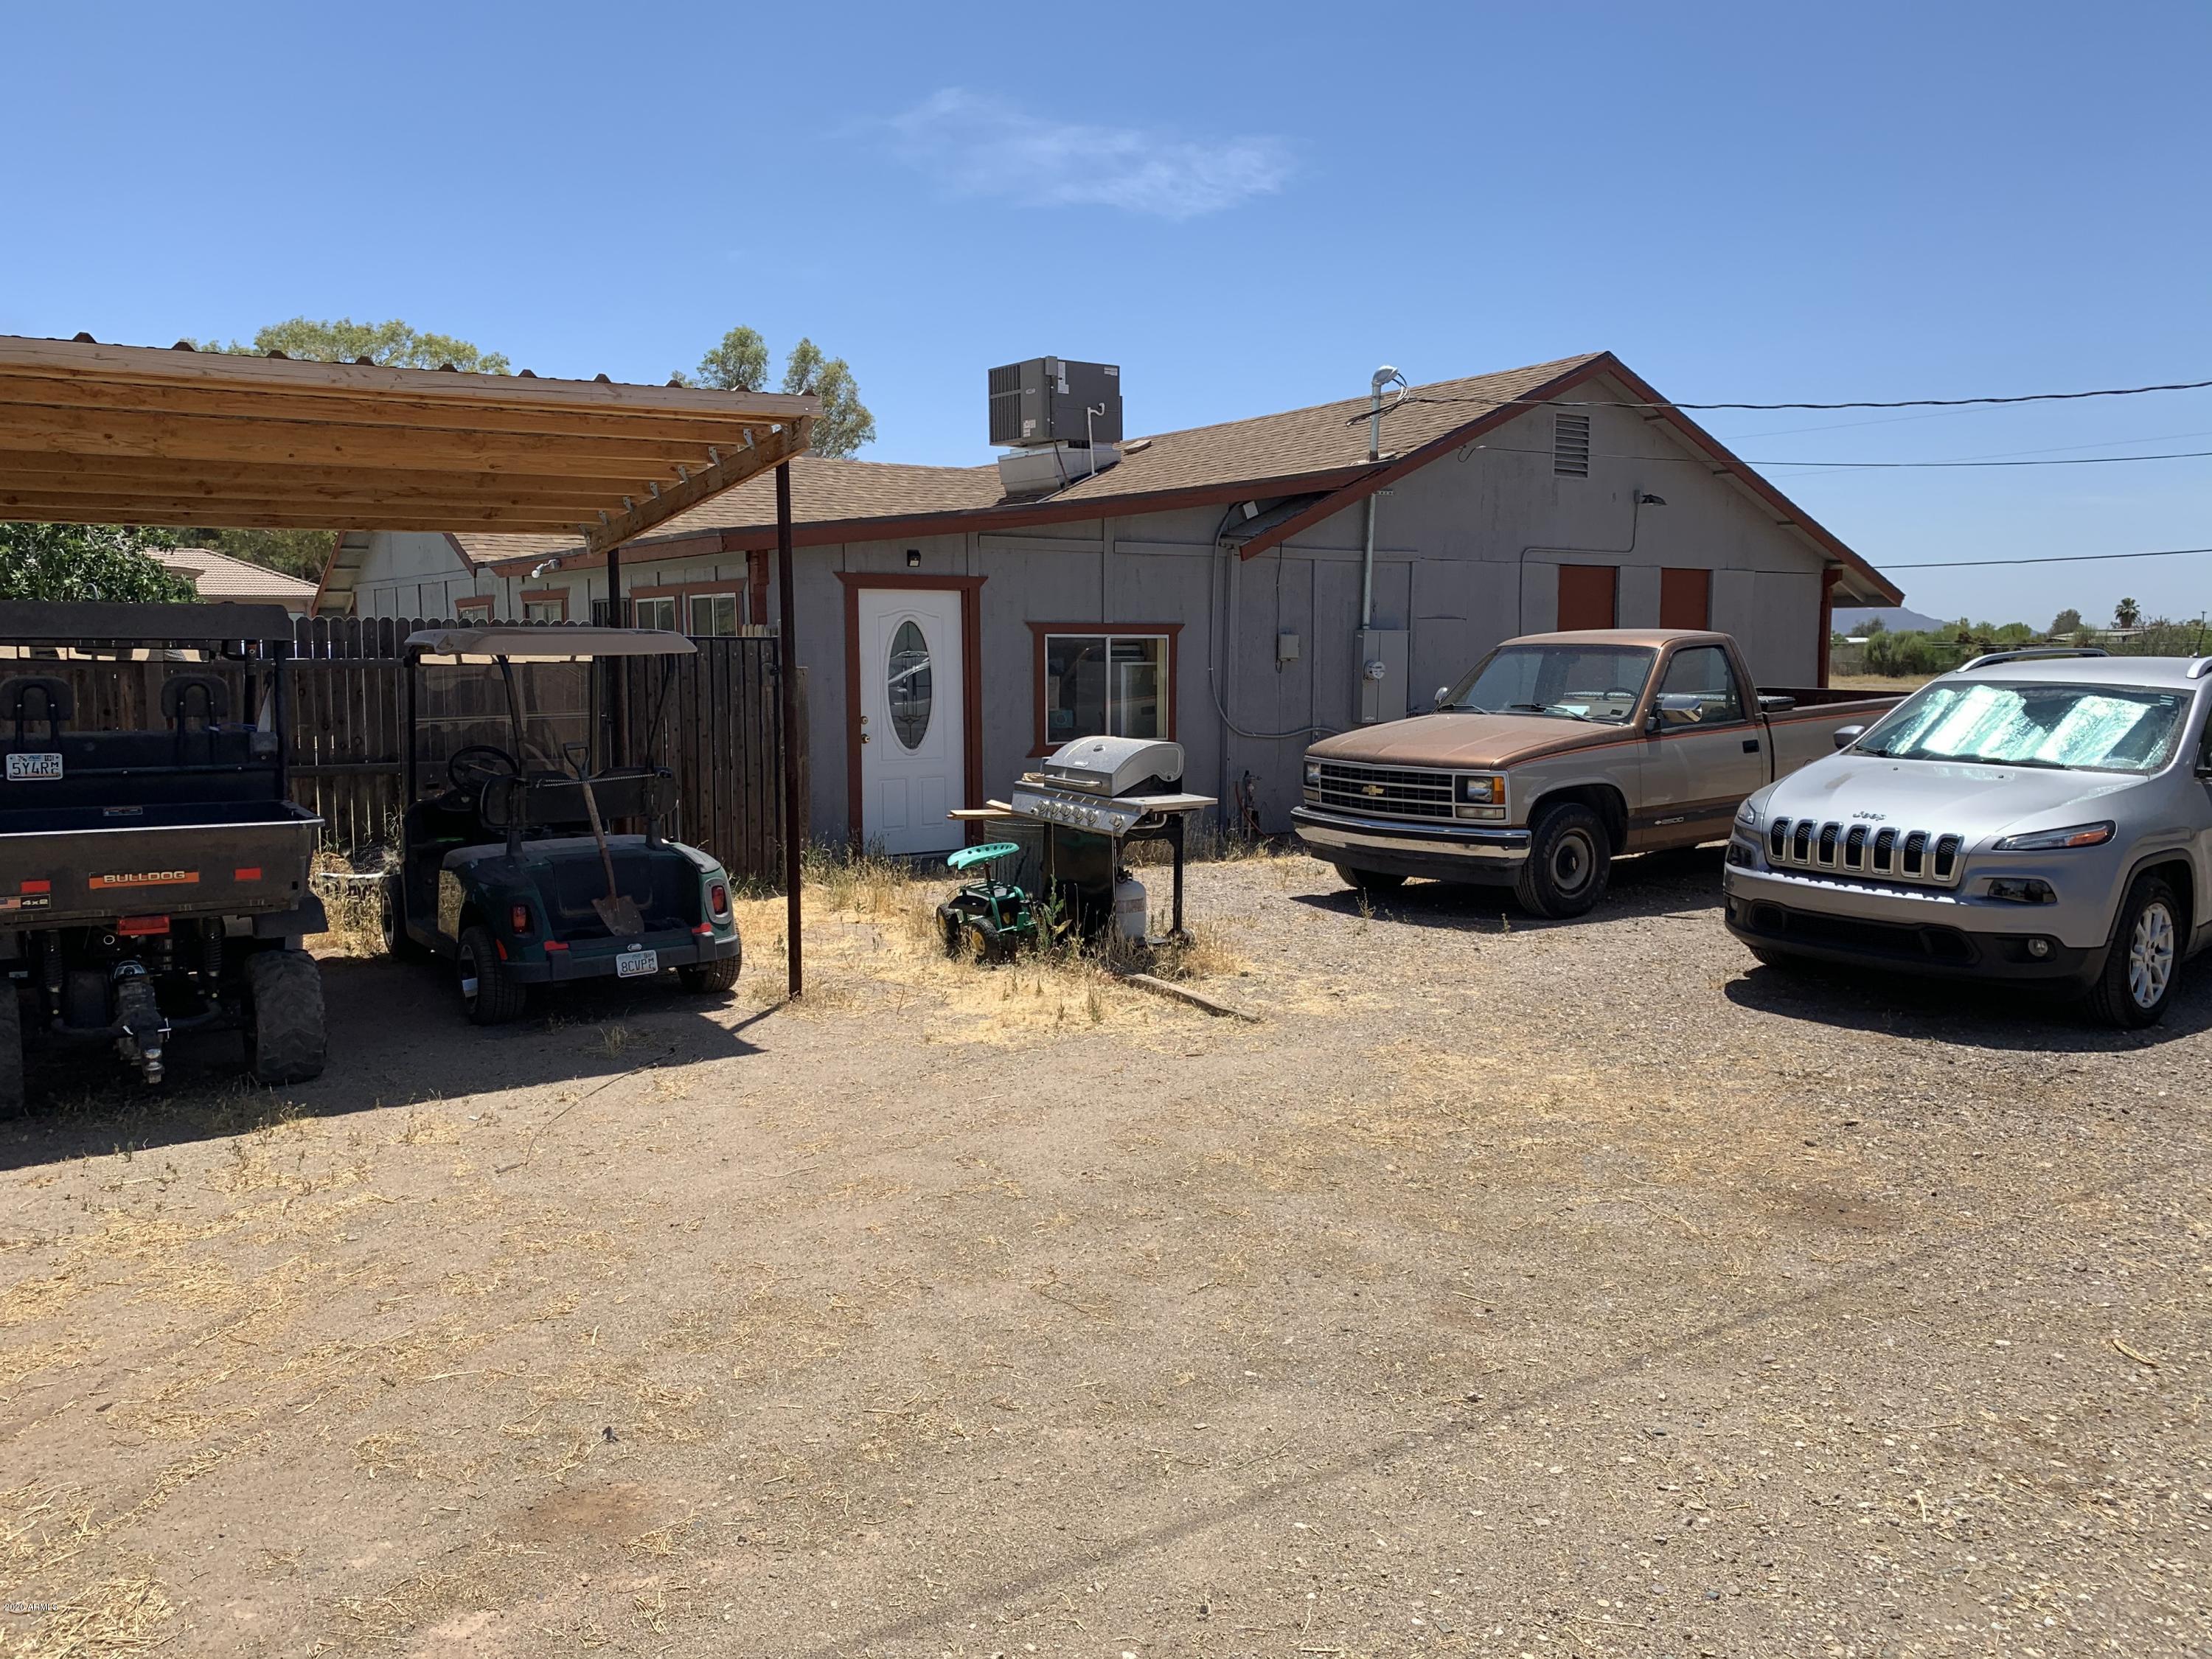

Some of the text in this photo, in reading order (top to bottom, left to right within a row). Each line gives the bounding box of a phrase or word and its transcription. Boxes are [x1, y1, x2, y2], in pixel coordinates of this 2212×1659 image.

[12, 762, 49, 775] 5Y4R
[1852, 811, 1887, 821] Jeep
[103, 871, 185, 883] BULLDOG
